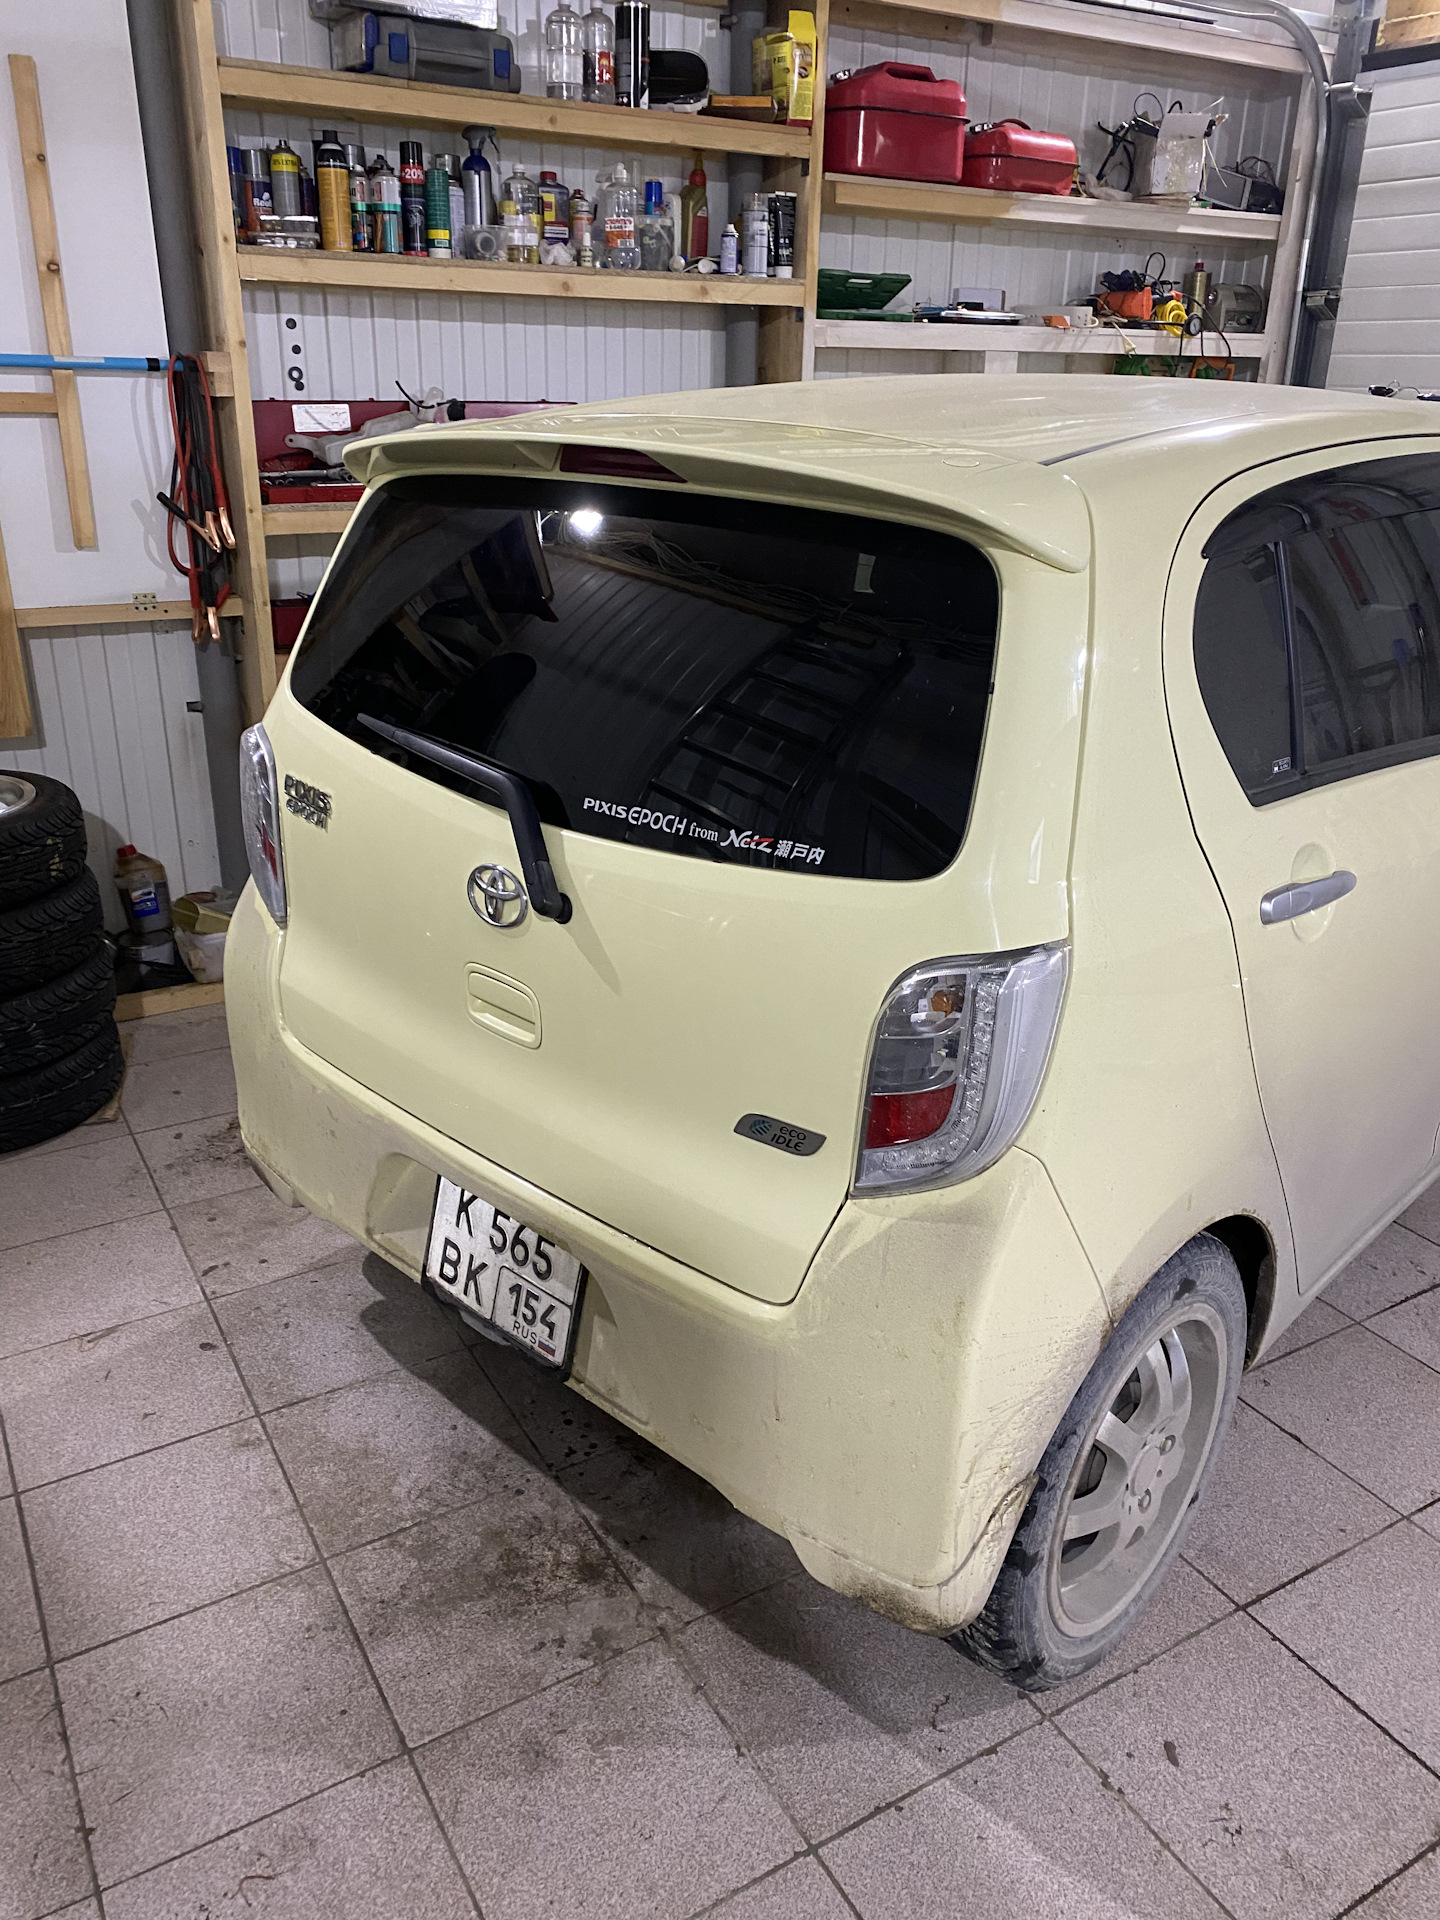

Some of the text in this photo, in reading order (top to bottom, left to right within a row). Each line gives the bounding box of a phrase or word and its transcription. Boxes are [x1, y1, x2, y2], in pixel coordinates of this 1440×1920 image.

[688, 821, 719, 842] from
[773, 839, 826, 866] 瀬戸内
[770, 1133, 805, 1152] IDLE
[779, 1126, 807, 1141] eco
[488, 1207, 557, 1281] 565
[508, 1282, 557, 1341] 154
[511, 1320, 538, 1345] RUS
